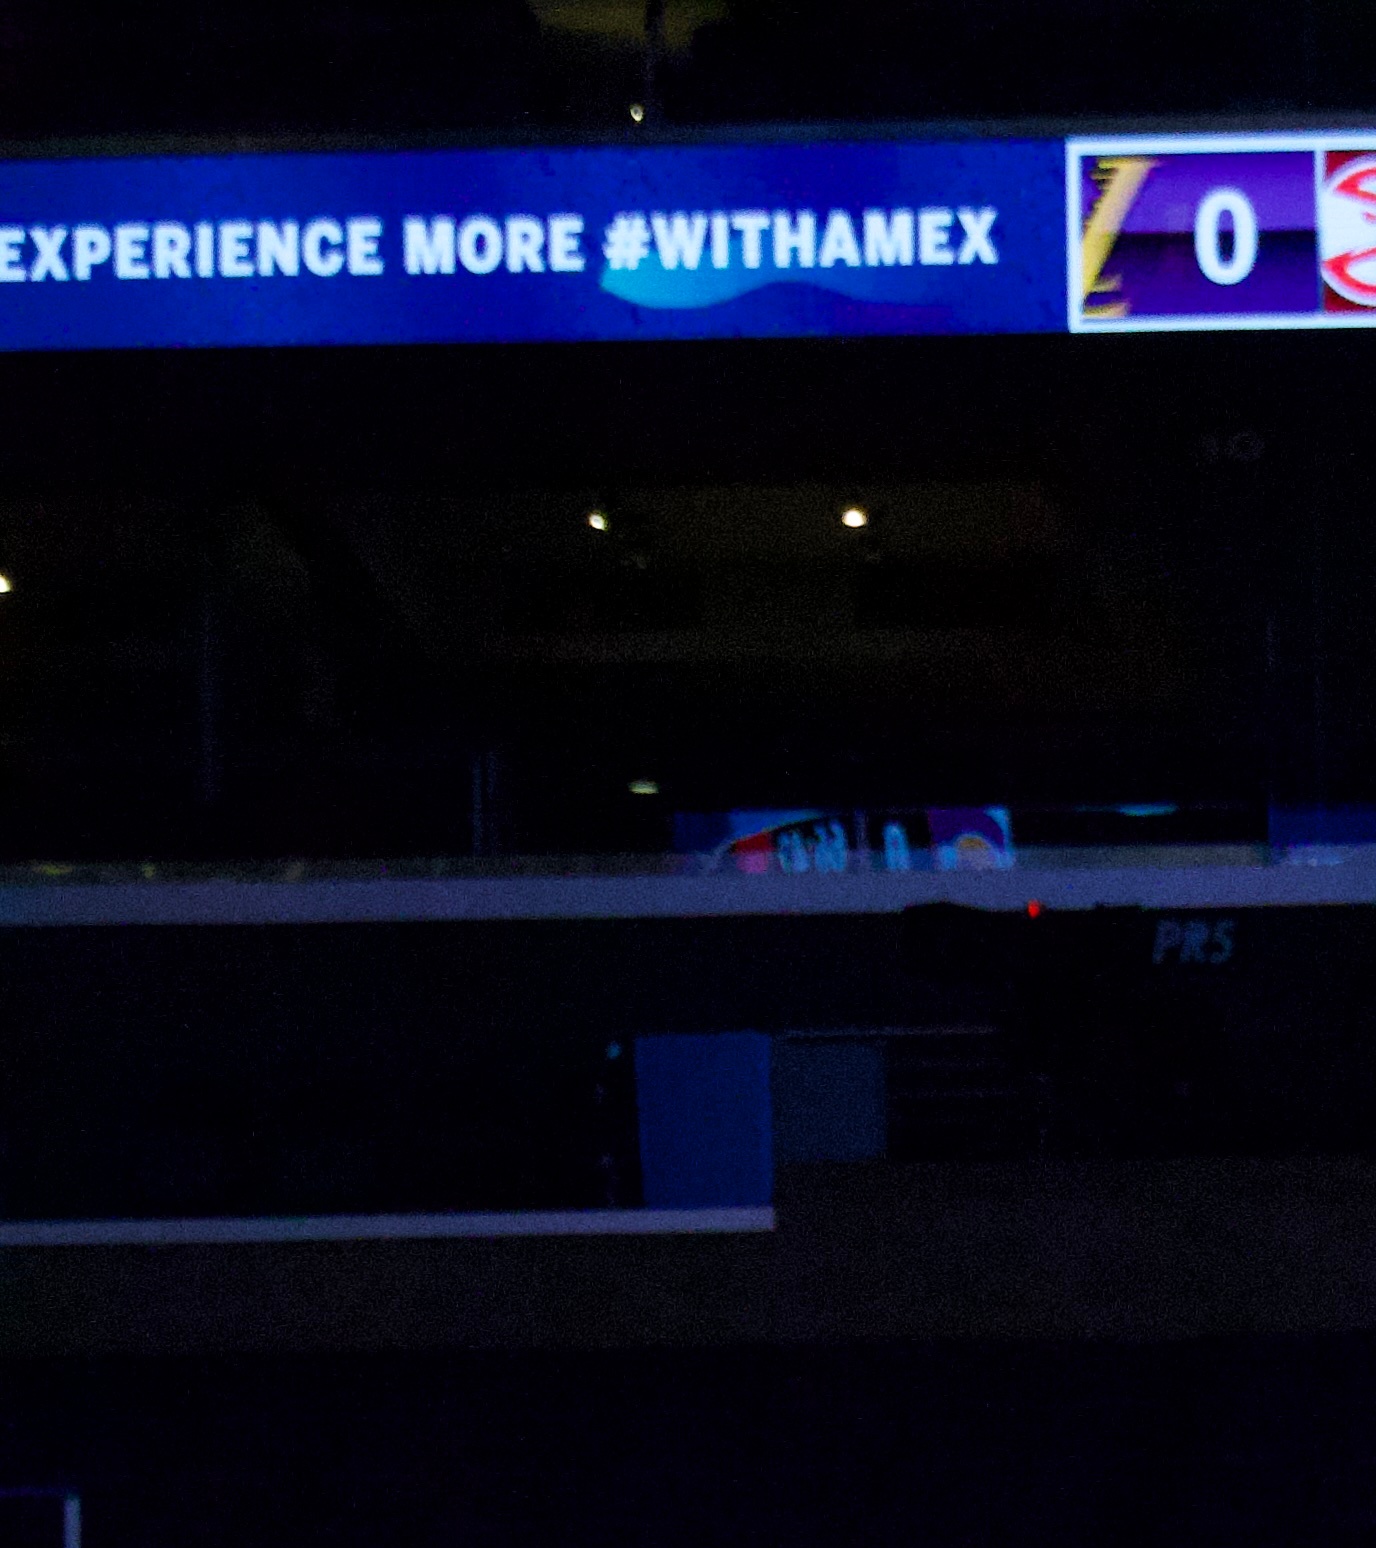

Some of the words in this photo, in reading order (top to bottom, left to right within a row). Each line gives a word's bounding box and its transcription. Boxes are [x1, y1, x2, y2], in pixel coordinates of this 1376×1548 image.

[0, 215, 384, 284] EXPERIENCE
[403, 211, 585, 278] MORE
[604, 205, 999, 272] #WITHAMEX
[1196, 187, 1259, 285] 0
